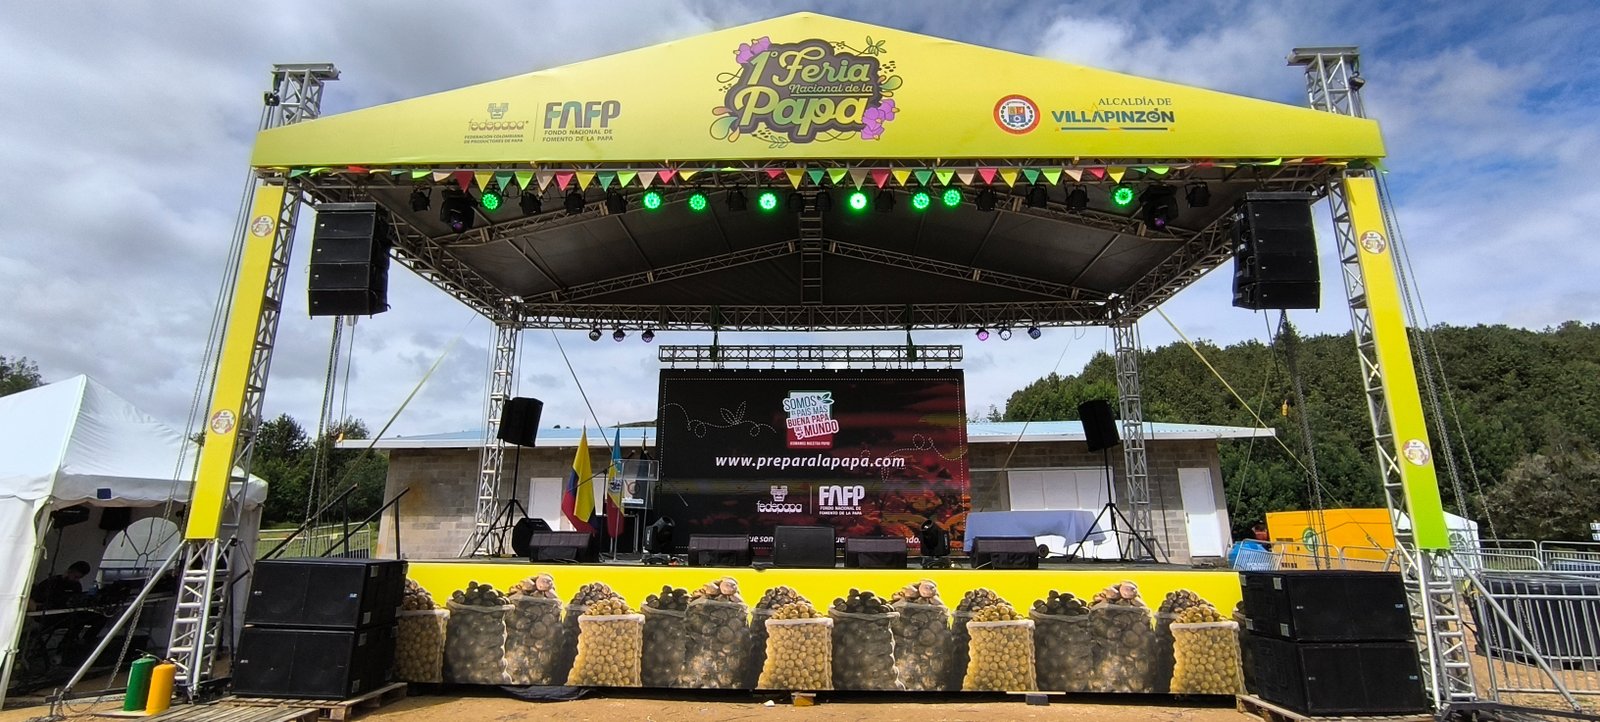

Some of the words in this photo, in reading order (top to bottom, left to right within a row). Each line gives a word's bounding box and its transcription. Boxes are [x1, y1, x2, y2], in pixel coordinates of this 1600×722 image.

[771, 46, 871, 87] Feria
[788, 84, 843, 94] Nacional
[845, 84, 861, 93] de
[861, 83, 873, 93] la
[1098, 96, 1155, 106] ALCALDÍA
[1157, 97, 1172, 106] DE
[734, 86, 869, 136] Papa
[1051, 108, 1175, 123] VILLAPINZÓN
[784, 395, 817, 411] SOMOS
[787, 416, 810, 428] BUENA
[811, 413, 830, 423] PAPA
[804, 420, 838, 436] MUNDO
[715, 453, 906, 471] www.preparalapapa.com
[756, 500, 802, 515] fedepapa
